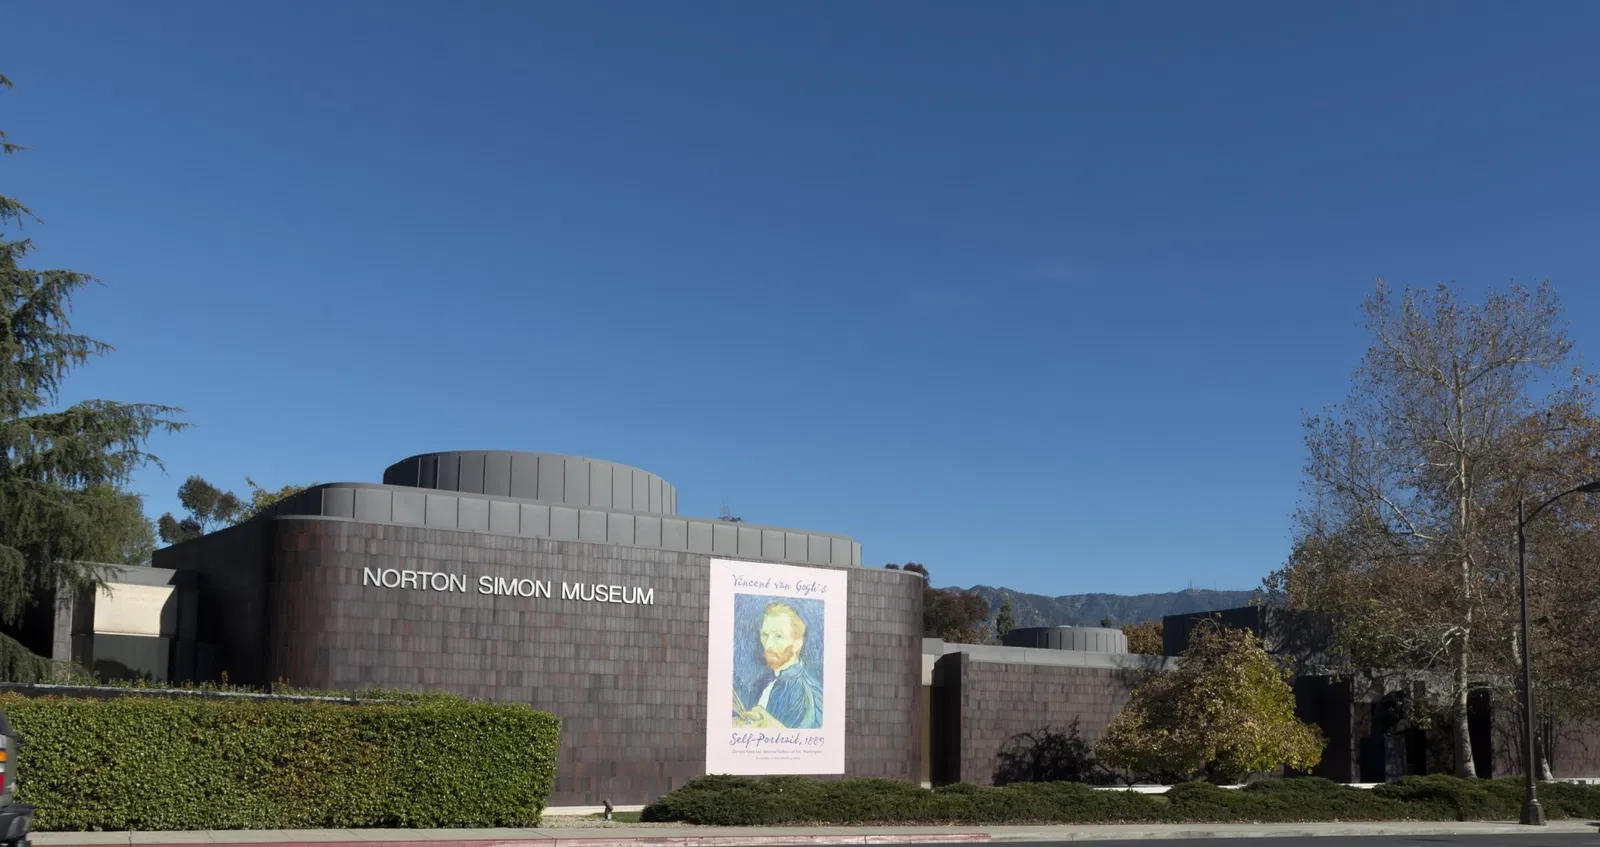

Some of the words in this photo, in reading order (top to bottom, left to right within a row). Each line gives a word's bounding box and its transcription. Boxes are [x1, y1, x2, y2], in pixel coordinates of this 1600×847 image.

[362, 567, 467, 593] NORTON
[478, 575, 551, 599] SIMON
[561, 581, 654, 605] MUSEUM
[732, 574, 772, 589] Vincent
[774, 582, 792, 590] van
[805, 736, 825, 747] 1889
